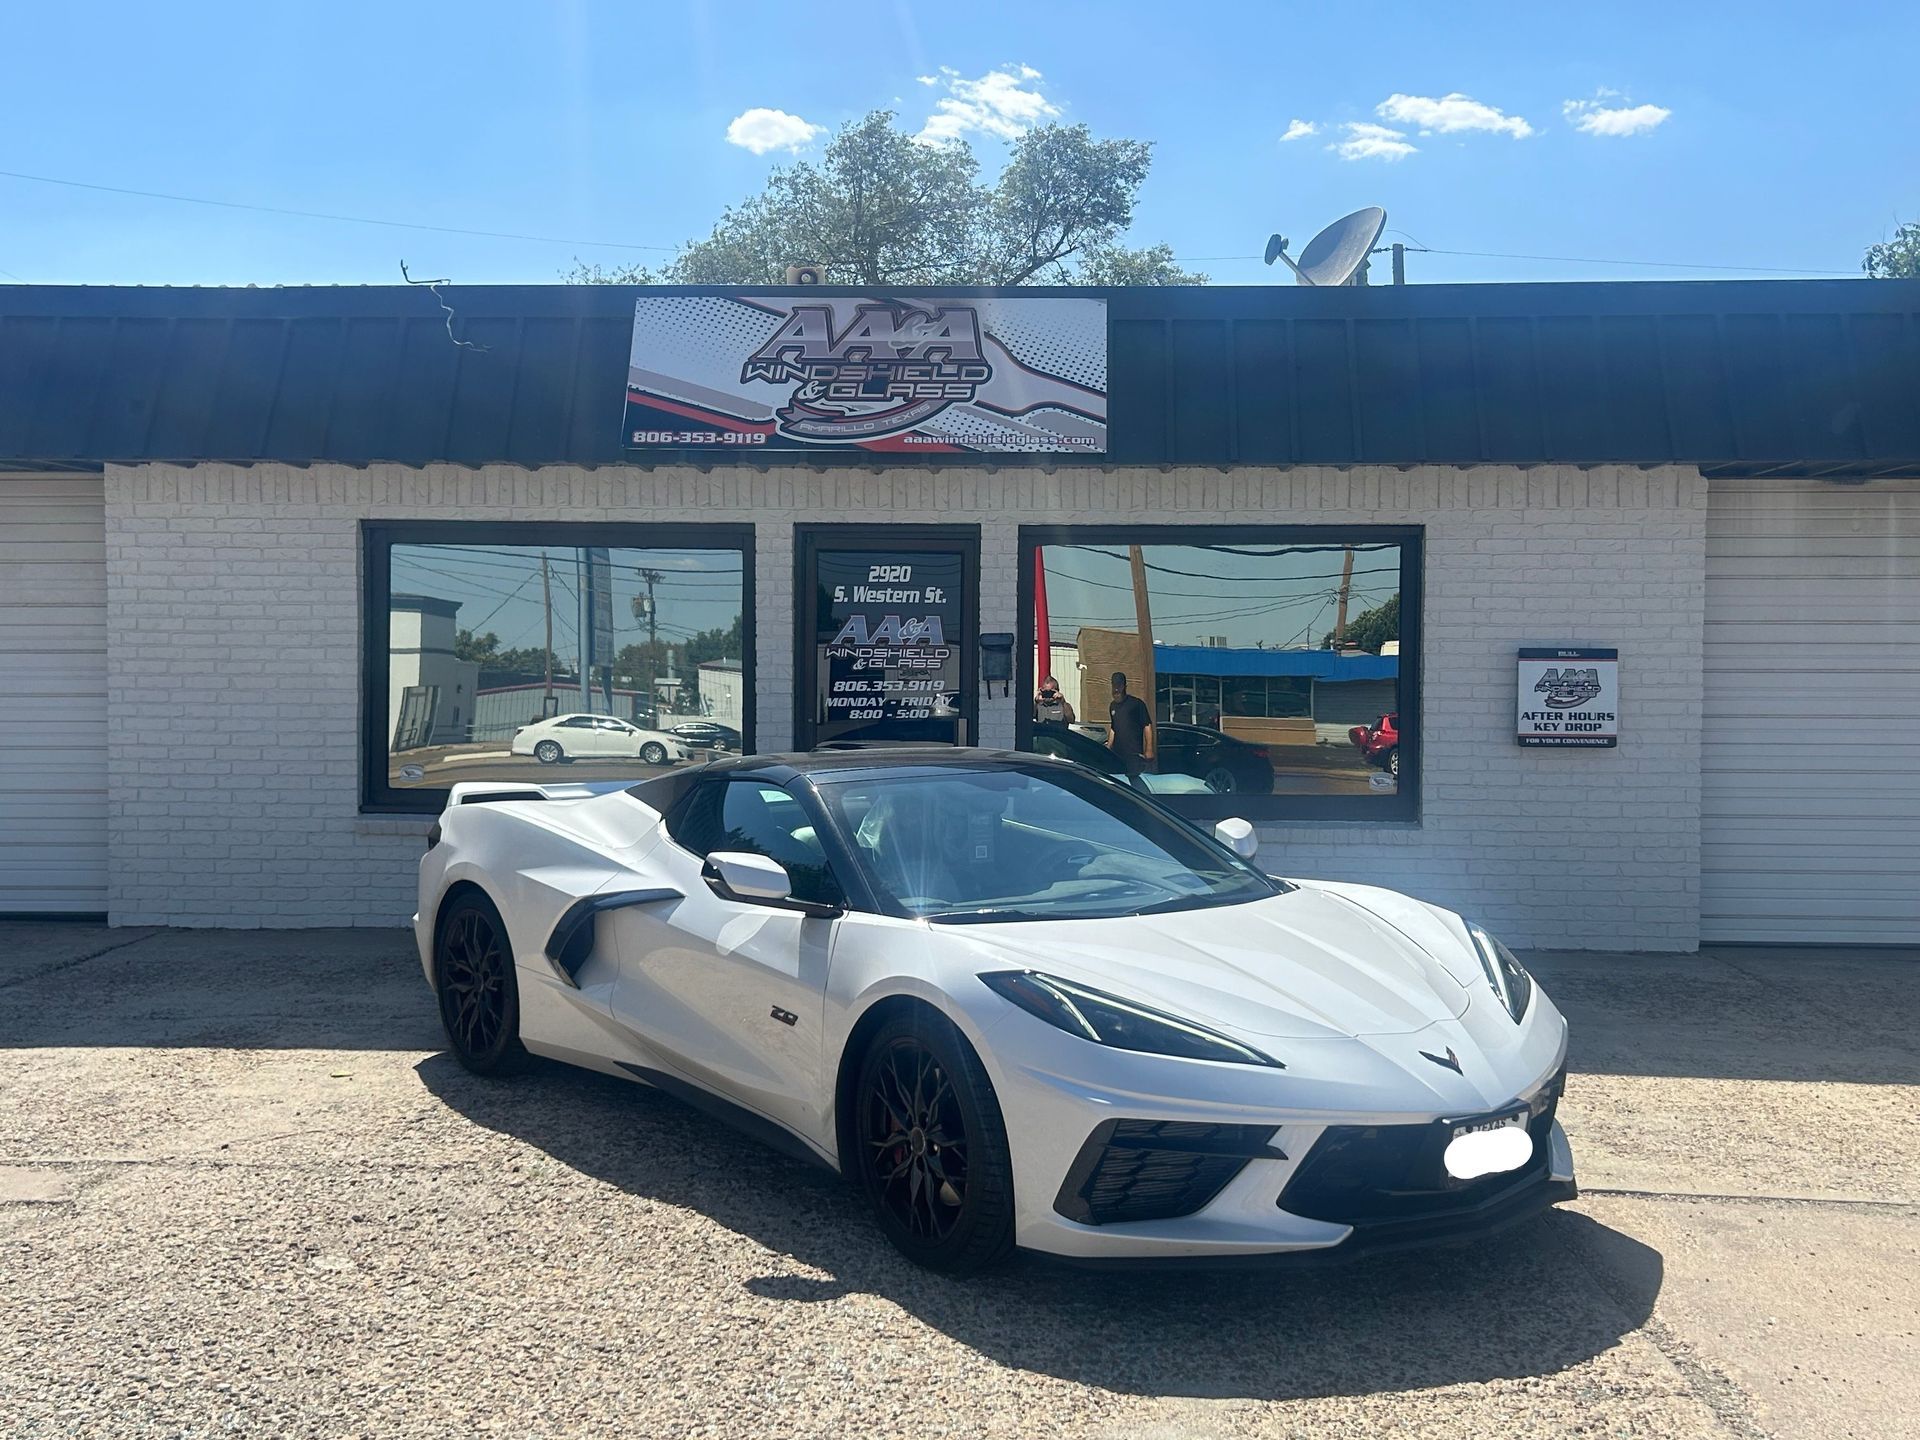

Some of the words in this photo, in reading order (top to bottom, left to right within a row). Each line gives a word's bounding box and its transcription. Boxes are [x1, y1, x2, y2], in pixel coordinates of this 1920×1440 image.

[746, 363, 989, 382] WINDSHIELD
[828, 383, 972, 399] GLASS
[799, 422, 875, 433] AMARILLO
[880, 404, 931, 427] TEXAS
[632, 431, 767, 444] 806-353-9119
[903, 435, 1096, 446] aaawindshieldglass.com
[868, 565, 912, 583] 2920
[833, 586, 849, 603] S.
[853, 586, 920, 603] Western
[924, 587, 947, 604] St.
[826, 648, 950, 658] WINDSHIELD
[868, 659, 942, 668] GLASS
[833, 680, 945, 692] 806.353.9119
[825, 697, 887, 707] MONDAY
[900, 697, 954, 707] FRIDAY
[849, 709, 884, 719] 8:00
[895, 709, 930, 719] 5:00
[1521, 712, 1564, 721] AFTER
[1568, 712, 1615, 721] HOURS
[1534, 723, 1560, 732] KEY
[1564, 723, 1602, 732] DROP
